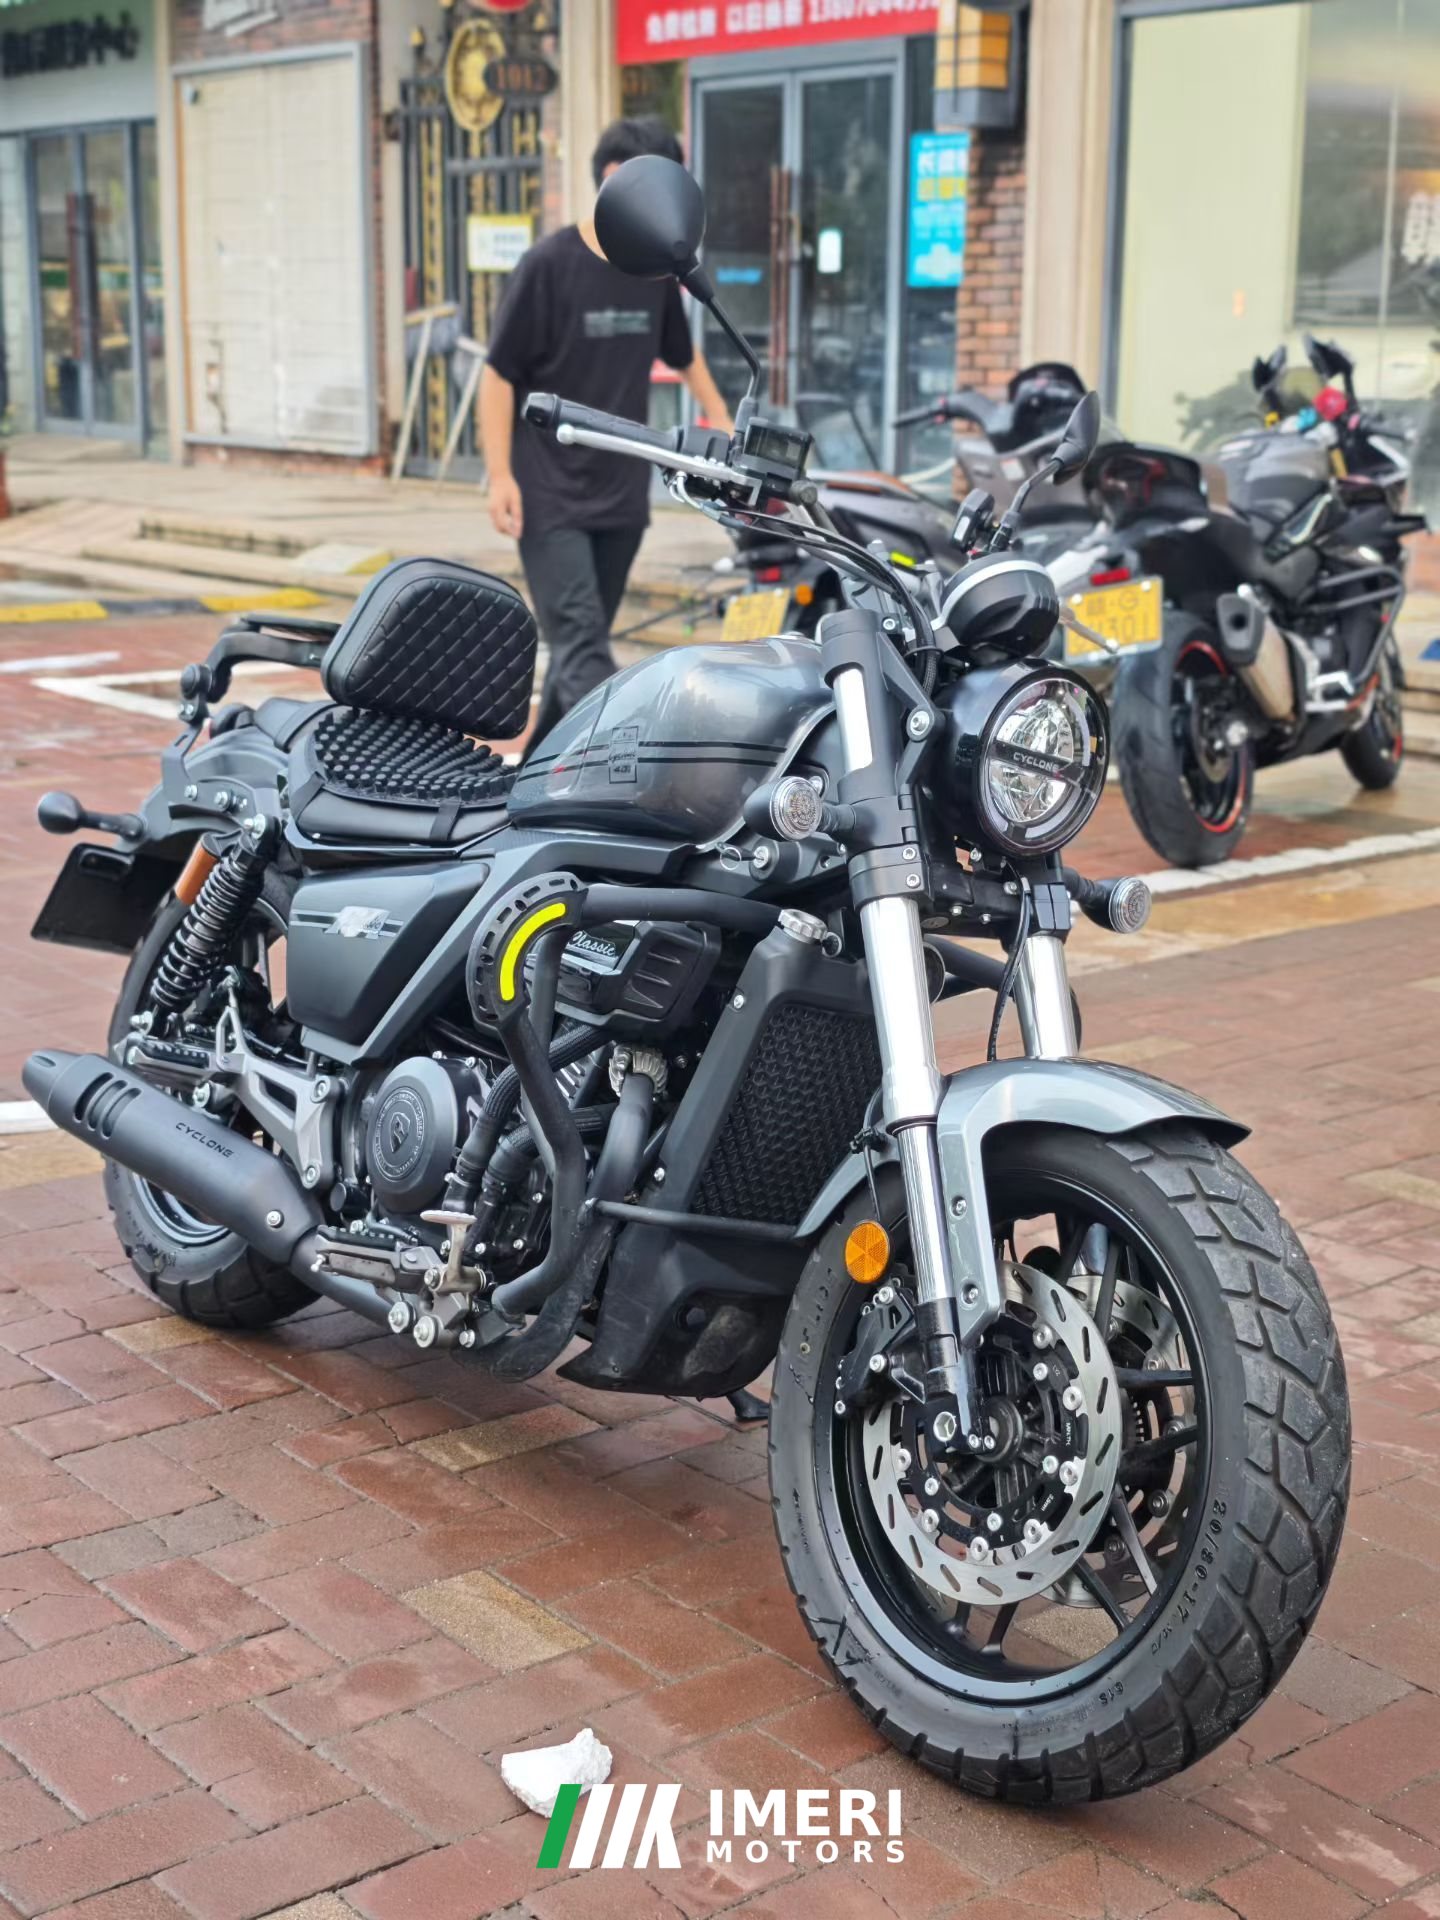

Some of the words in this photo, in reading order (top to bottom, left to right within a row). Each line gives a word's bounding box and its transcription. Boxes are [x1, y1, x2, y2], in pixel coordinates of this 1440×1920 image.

[1013, 752, 1060, 773] CYCLONE
[568, 930, 615, 956] Classic
[175, 1122, 234, 1158] CYCLONE
